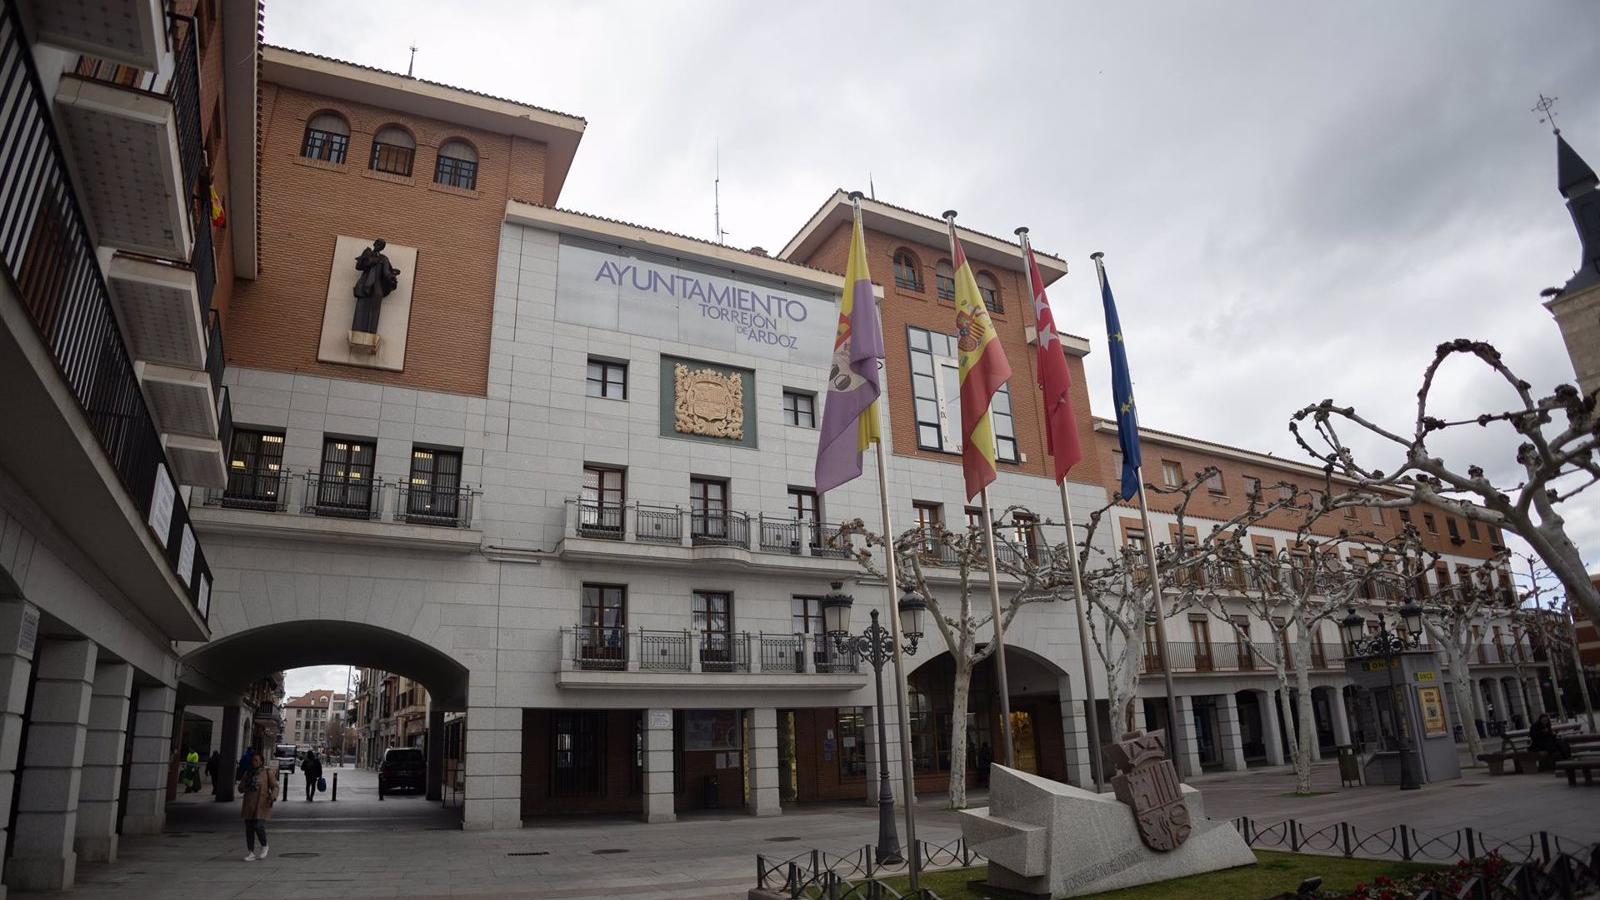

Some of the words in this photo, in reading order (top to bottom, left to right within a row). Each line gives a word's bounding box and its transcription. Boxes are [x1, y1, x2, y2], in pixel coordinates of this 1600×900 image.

[595, 260, 807, 322] AYUNTAMIENTO
[699, 304, 777, 330] TORREJÓN
[737, 325, 749, 335] DE
[748, 329, 798, 350] ARDOZ
